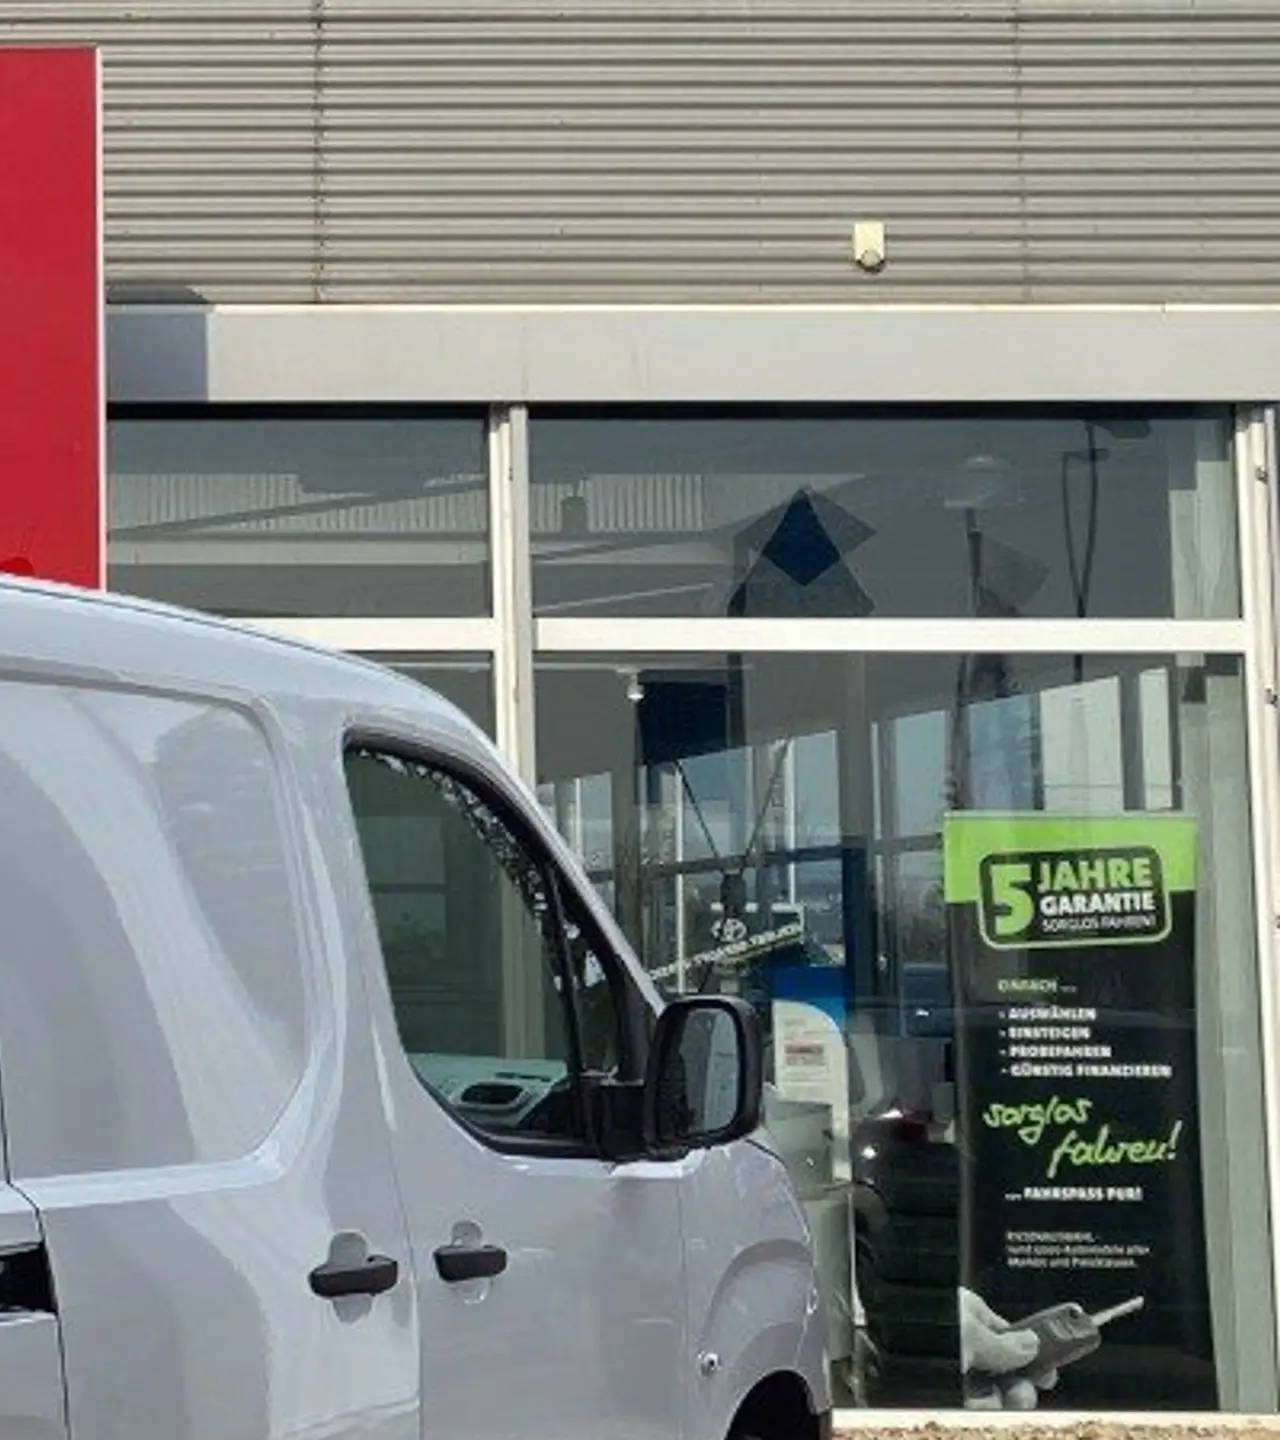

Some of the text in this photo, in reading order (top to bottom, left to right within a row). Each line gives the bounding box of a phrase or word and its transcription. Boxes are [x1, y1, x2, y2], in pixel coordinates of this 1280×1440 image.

[991, 856, 1153, 936] 5 JAHRE
[1040, 890, 1157, 917] GARANTIE
[1042, 917, 1098, 932] SORGLOS
[1008, 1004, 1097, 1021] AUSWÄHLEN
[1008, 1026, 1091, 1040] EINSTEIGEN
[1009, 1045, 1112, 1058] PROBEFAHREN
[1010, 1061, 1173, 1079] GÜNSTIG FINANZIEREN
[983, 1095, 1093, 1144] sorglos
